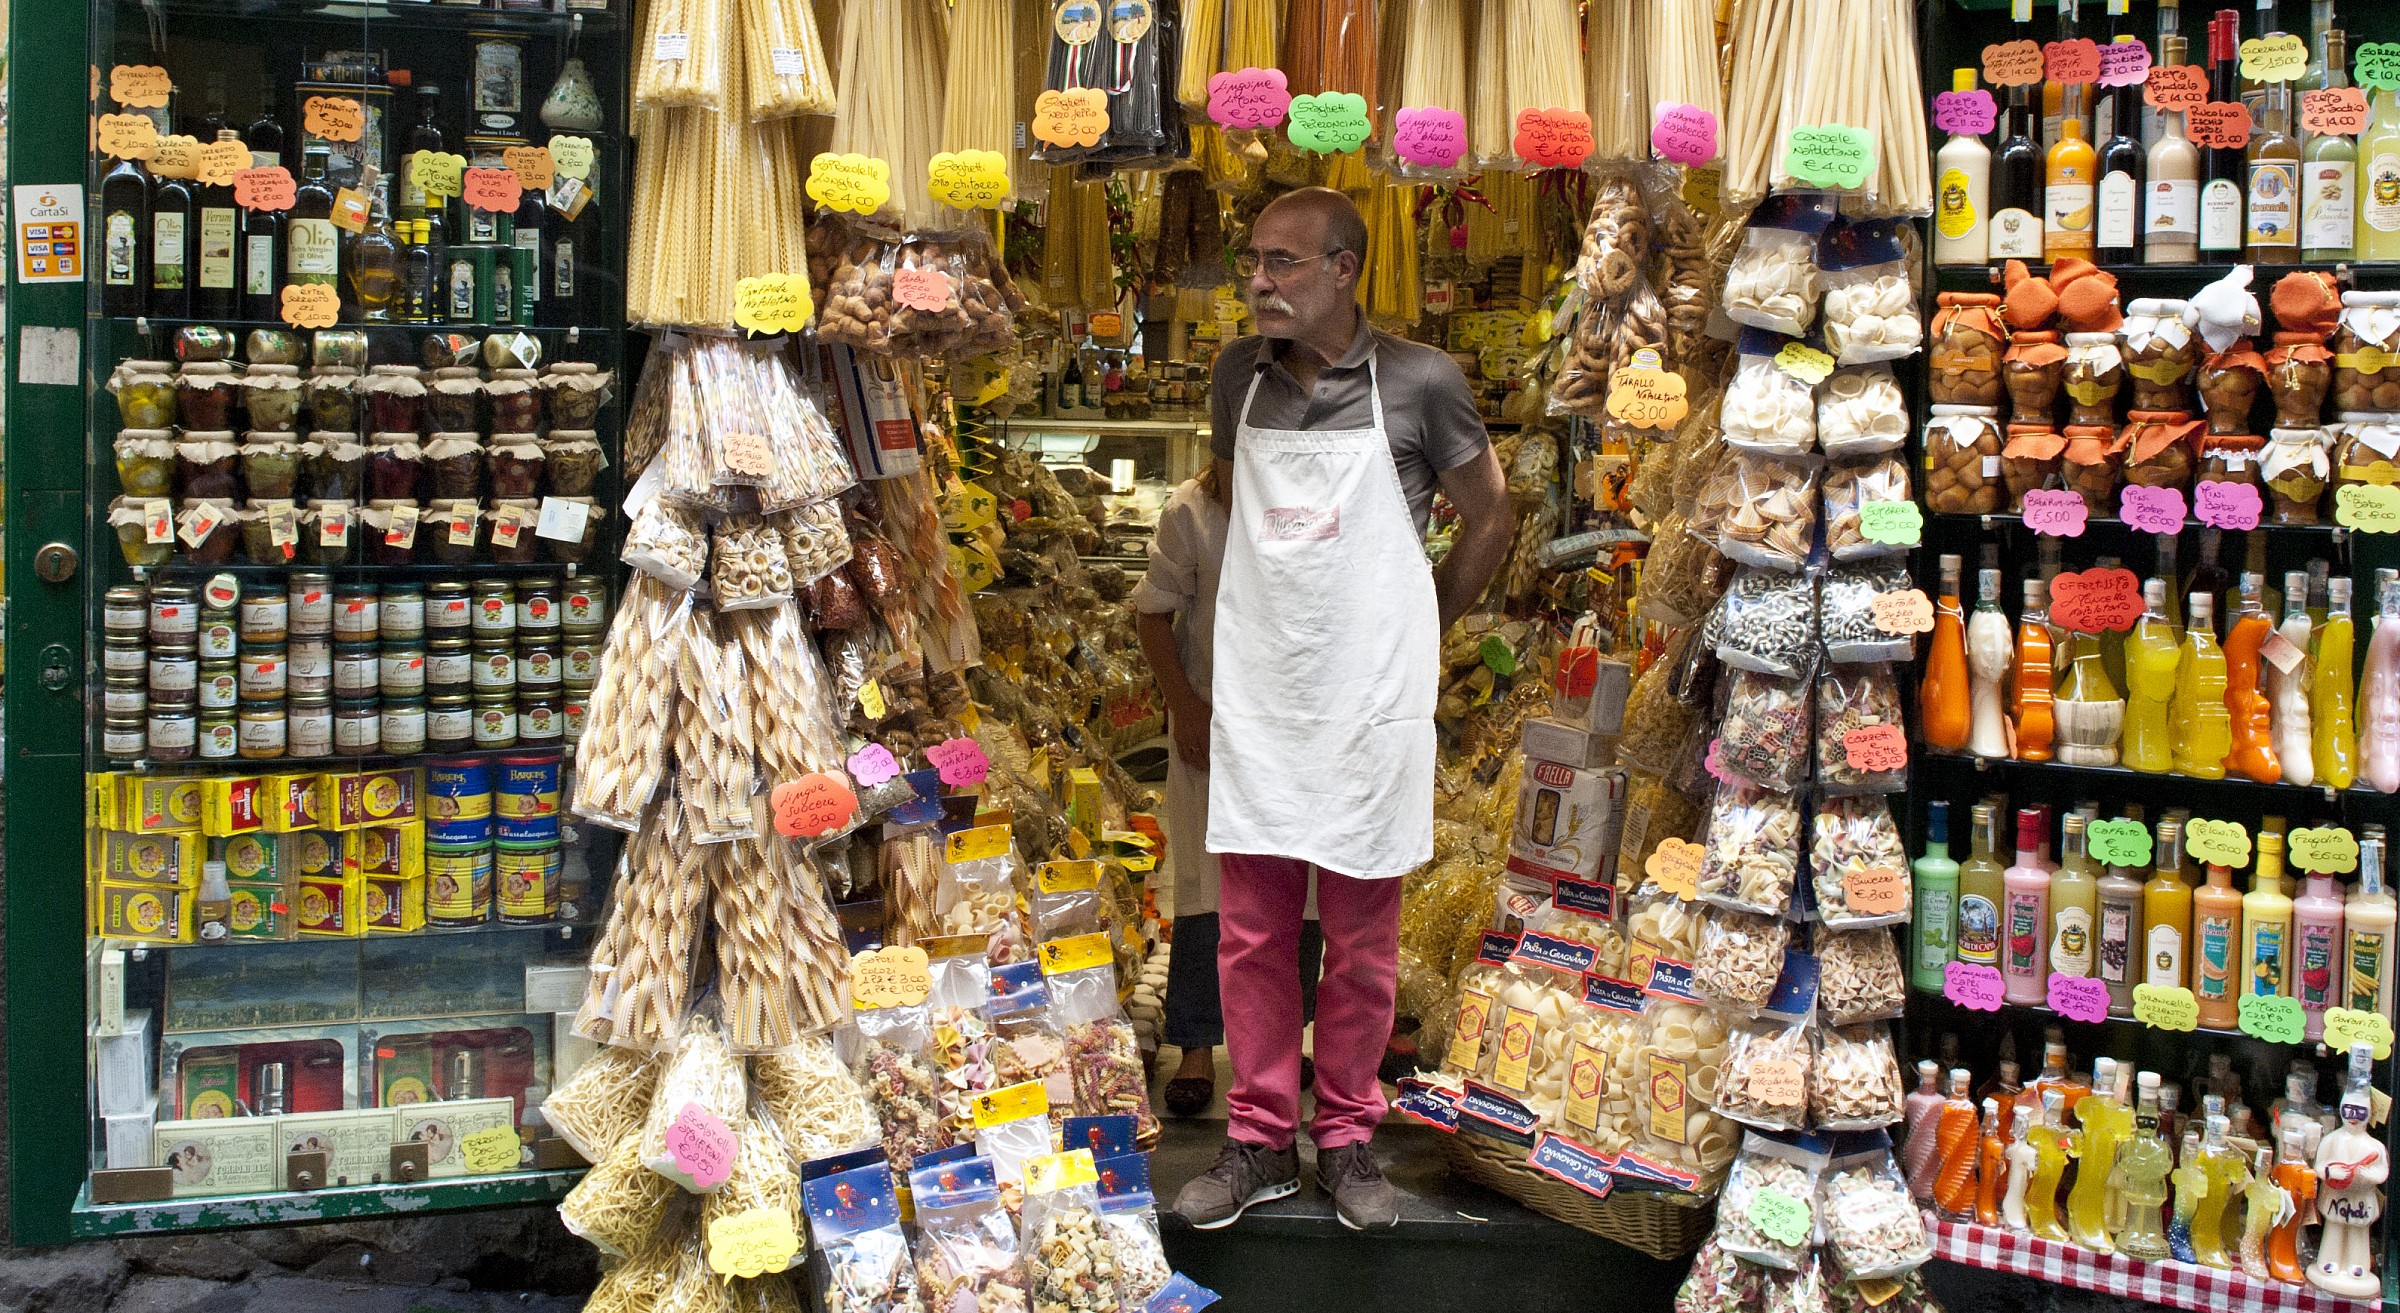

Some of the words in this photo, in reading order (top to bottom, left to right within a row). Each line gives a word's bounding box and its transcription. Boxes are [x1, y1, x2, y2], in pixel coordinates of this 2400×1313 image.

[30, 206, 69, 218] CartaSi
[29, 229, 47, 237] VISA
[30, 244, 49, 253] VISA
[1537, 765, 1571, 785] FAELLA
[153, 789, 162, 814] EXICO
[1522, 941, 1542, 954] PASTA
[1549, 947, 1590, 967] GRAGNANO
[1655, 970, 1677, 984] PASTA
[1684, 976, 1692, 988] G
[1589, 984, 1606, 997] PASTA
[1468, 1095, 1507, 1116] GRAGNANO
[1513, 1112, 1534, 1126] PASTA
[1541, 1145, 1582, 1171] GRAGNANO
[1588, 1167, 1610, 1183] PASTA
[2326, 1197, 2371, 1224] Napoli
